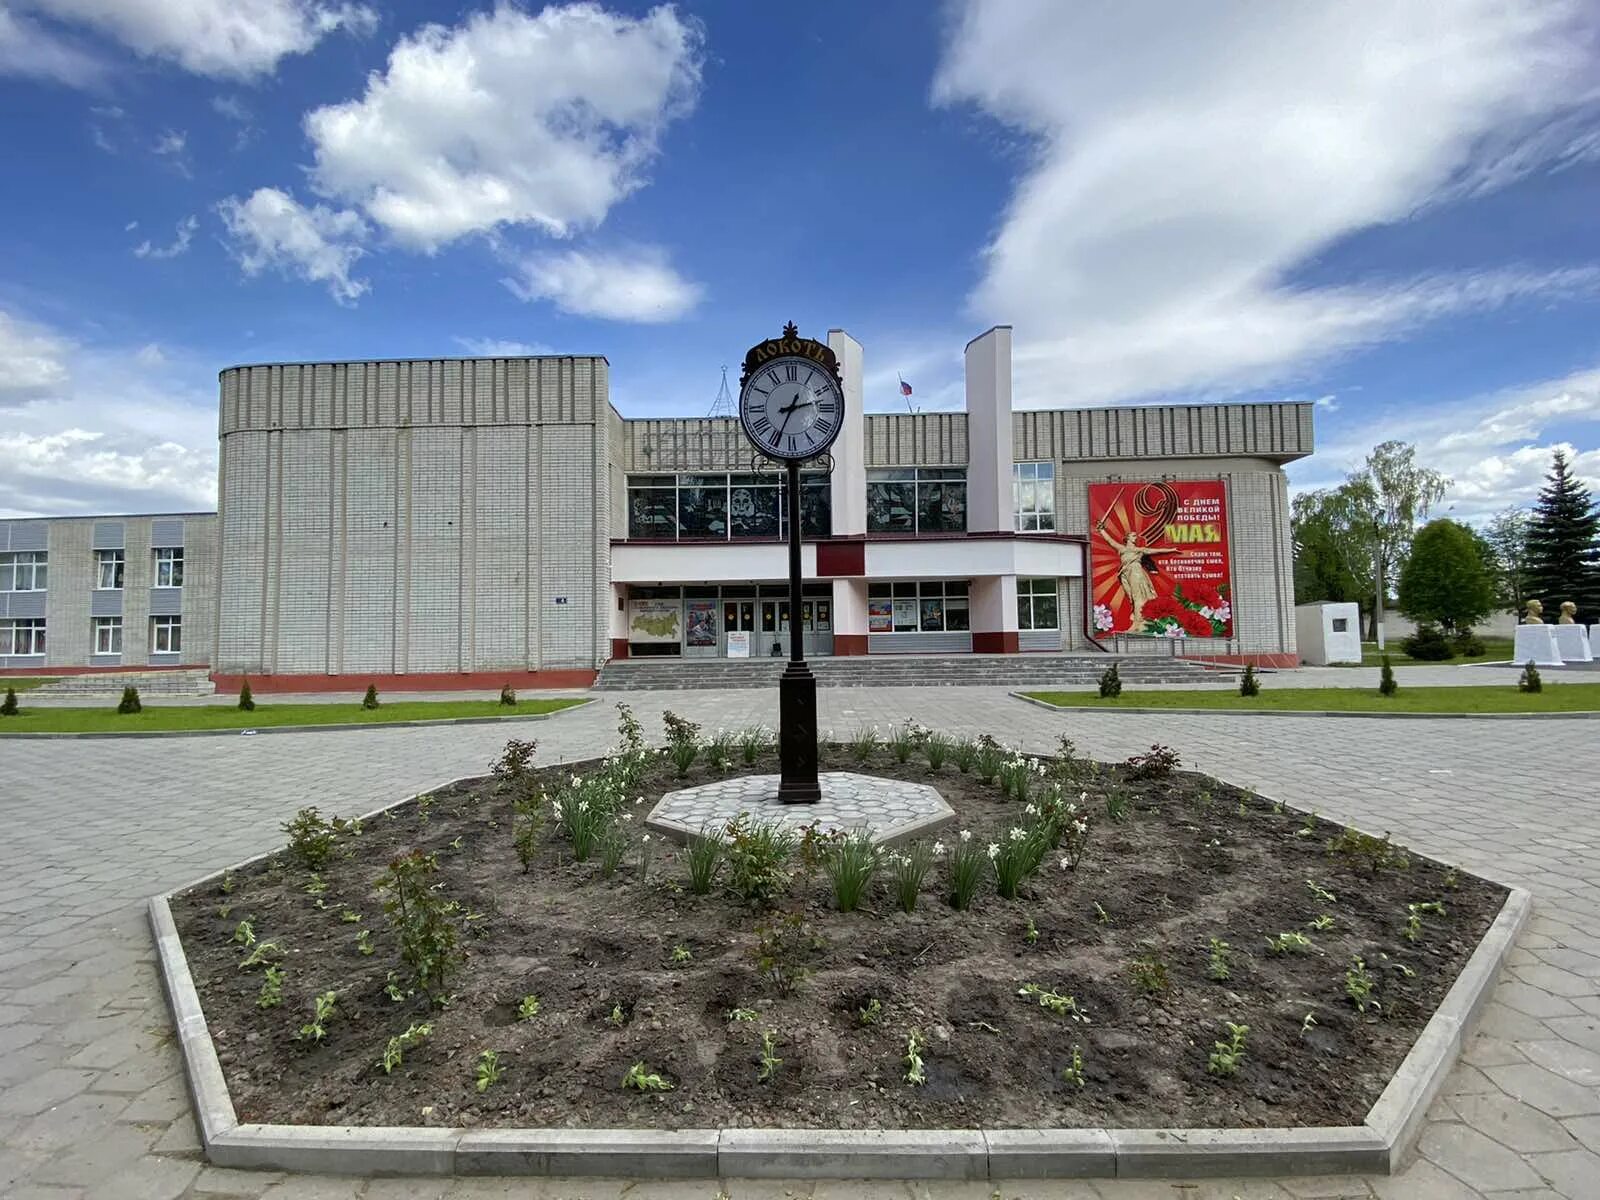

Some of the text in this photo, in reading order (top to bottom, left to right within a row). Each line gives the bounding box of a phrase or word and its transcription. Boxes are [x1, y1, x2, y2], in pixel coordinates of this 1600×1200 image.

[756, 340, 825, 362] ЛОКОТЬ
[1183, 498, 1220, 506] С ДНЕМ
[1165, 523, 1221, 543] МАЯ
